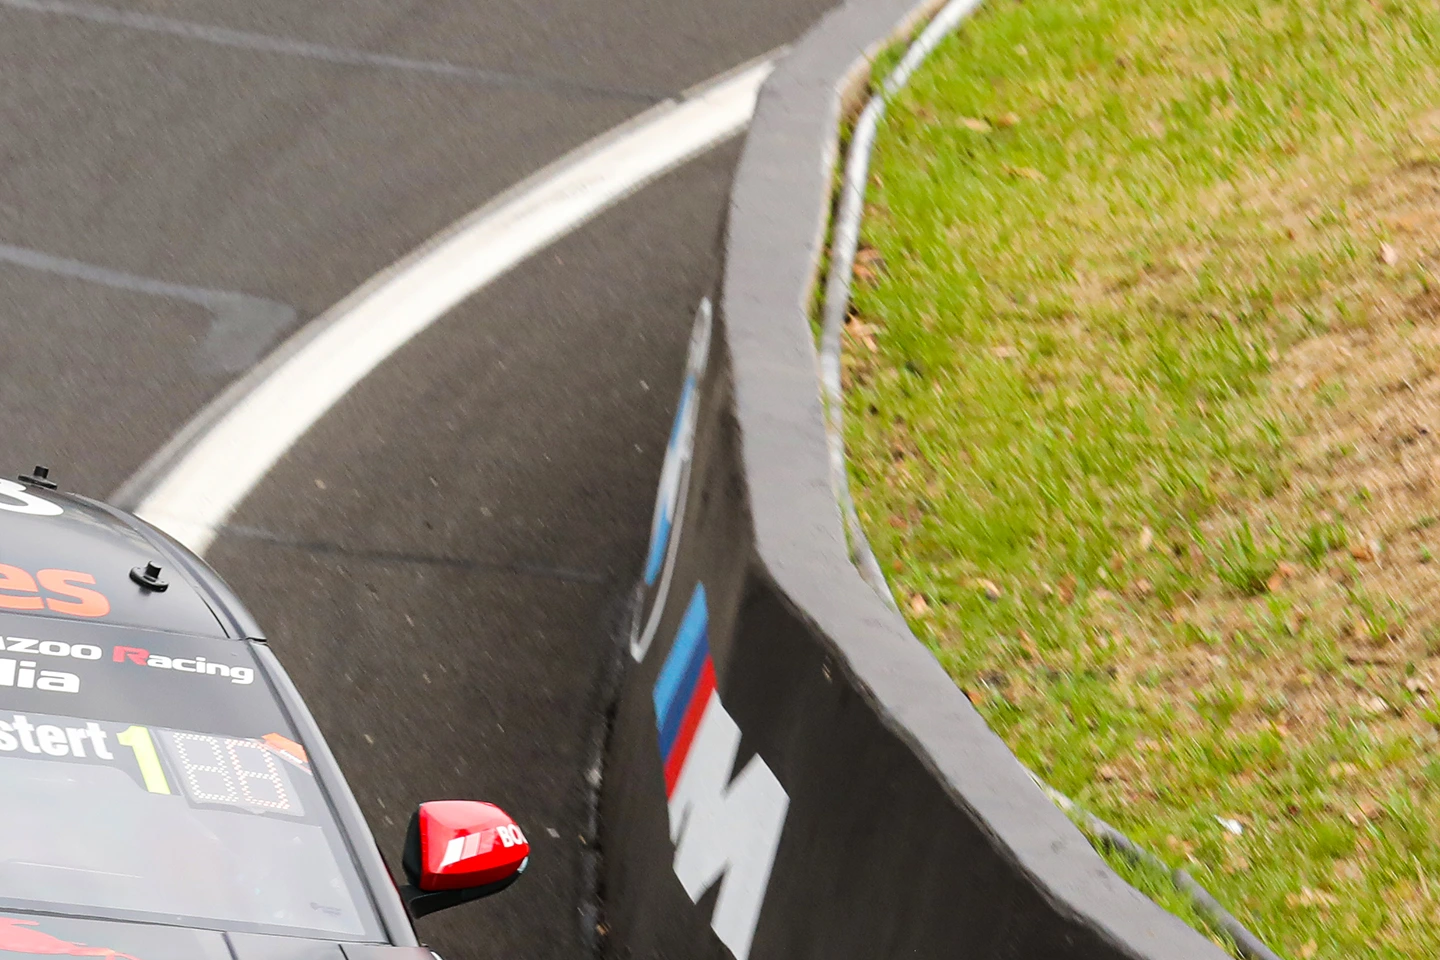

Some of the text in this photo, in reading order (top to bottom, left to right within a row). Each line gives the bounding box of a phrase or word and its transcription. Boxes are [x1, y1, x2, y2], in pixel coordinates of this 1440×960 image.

[112, 645, 254, 685] Racing
[116, 725, 171, 795] 1
[496, 823, 529, 848] BO
